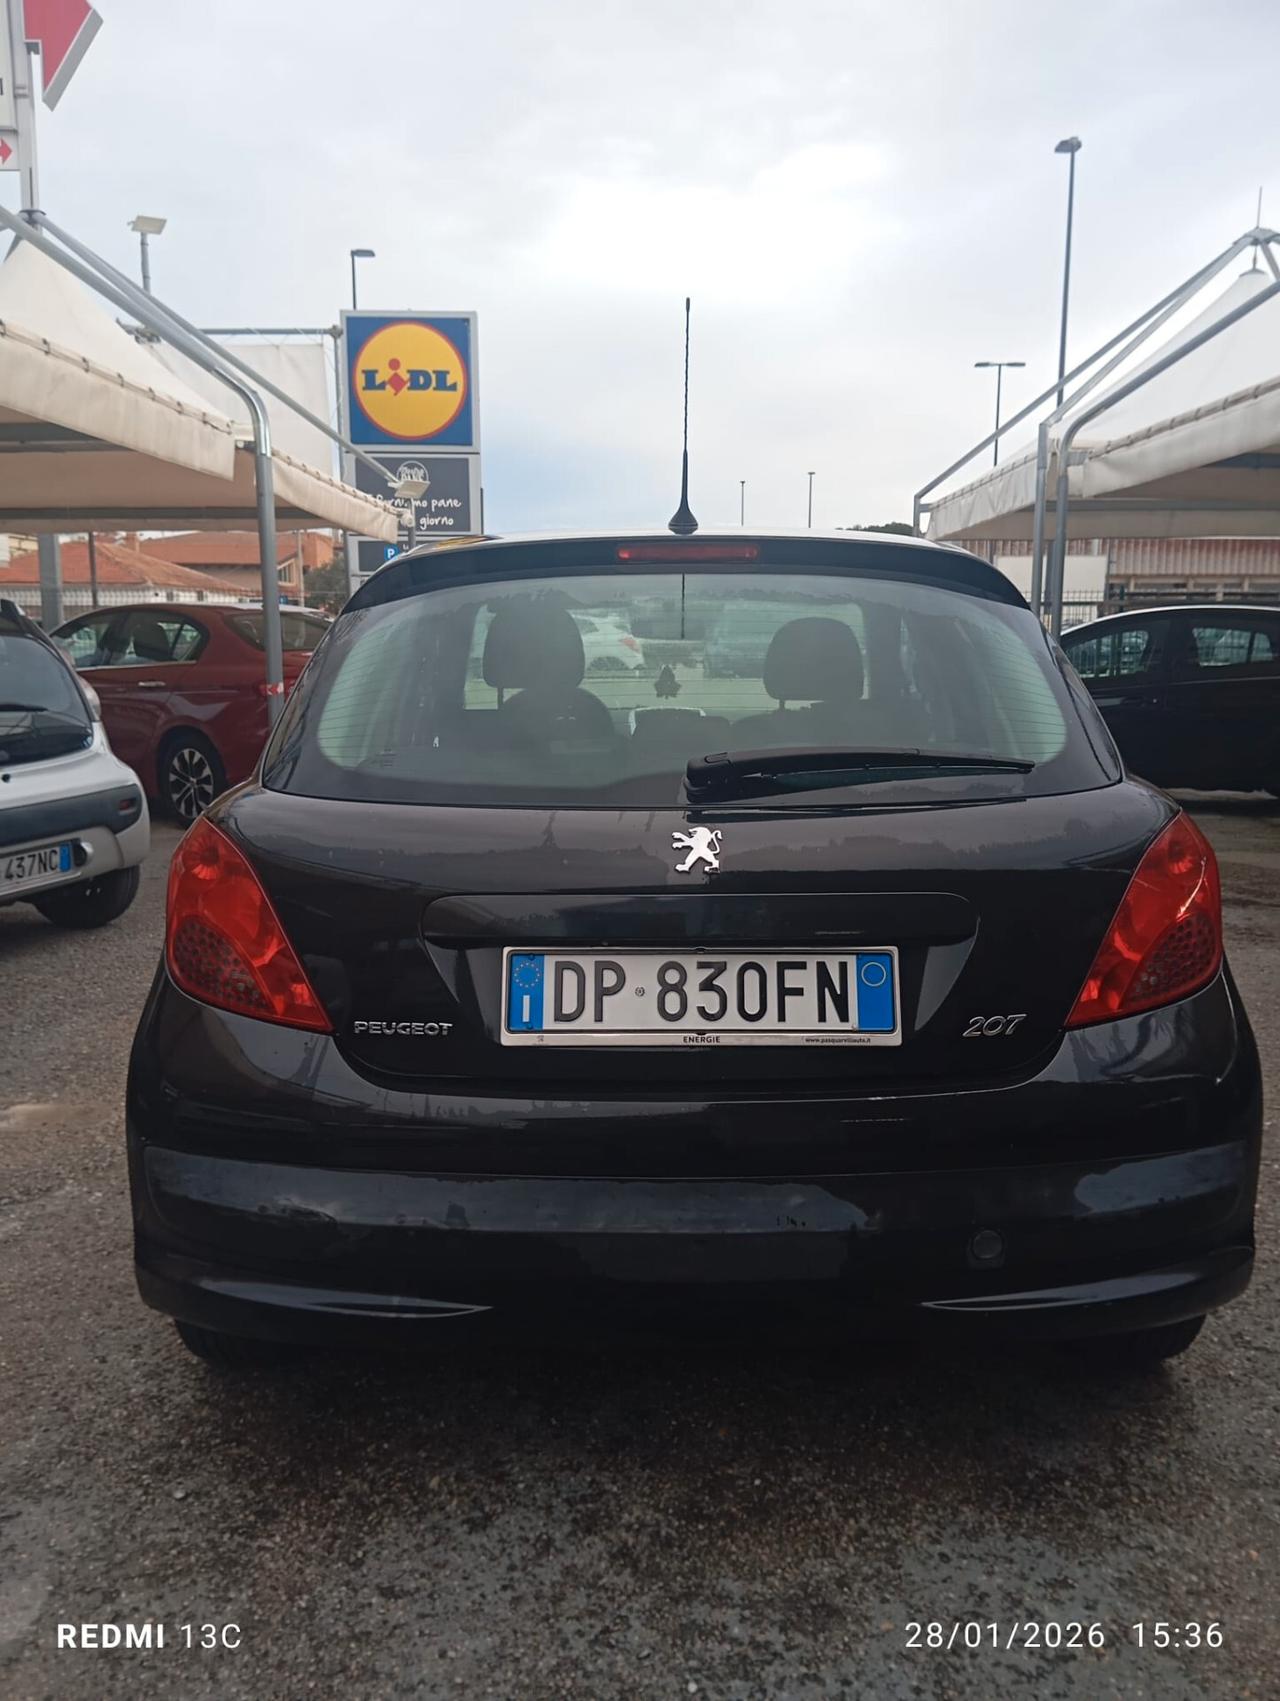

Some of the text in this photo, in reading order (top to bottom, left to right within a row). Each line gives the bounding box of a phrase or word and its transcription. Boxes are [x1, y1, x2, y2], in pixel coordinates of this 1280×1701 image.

[431, 498, 462, 512] pane
[419, 513, 454, 530] giorno
[4, 849, 59, 880] 437NC
[554, 961, 850, 1023] DP 830FN
[354, 1020, 453, 1036] PEUGEOT
[962, 1013, 1027, 1038] 207
[683, 1035, 721, 1044] ENERGIE
